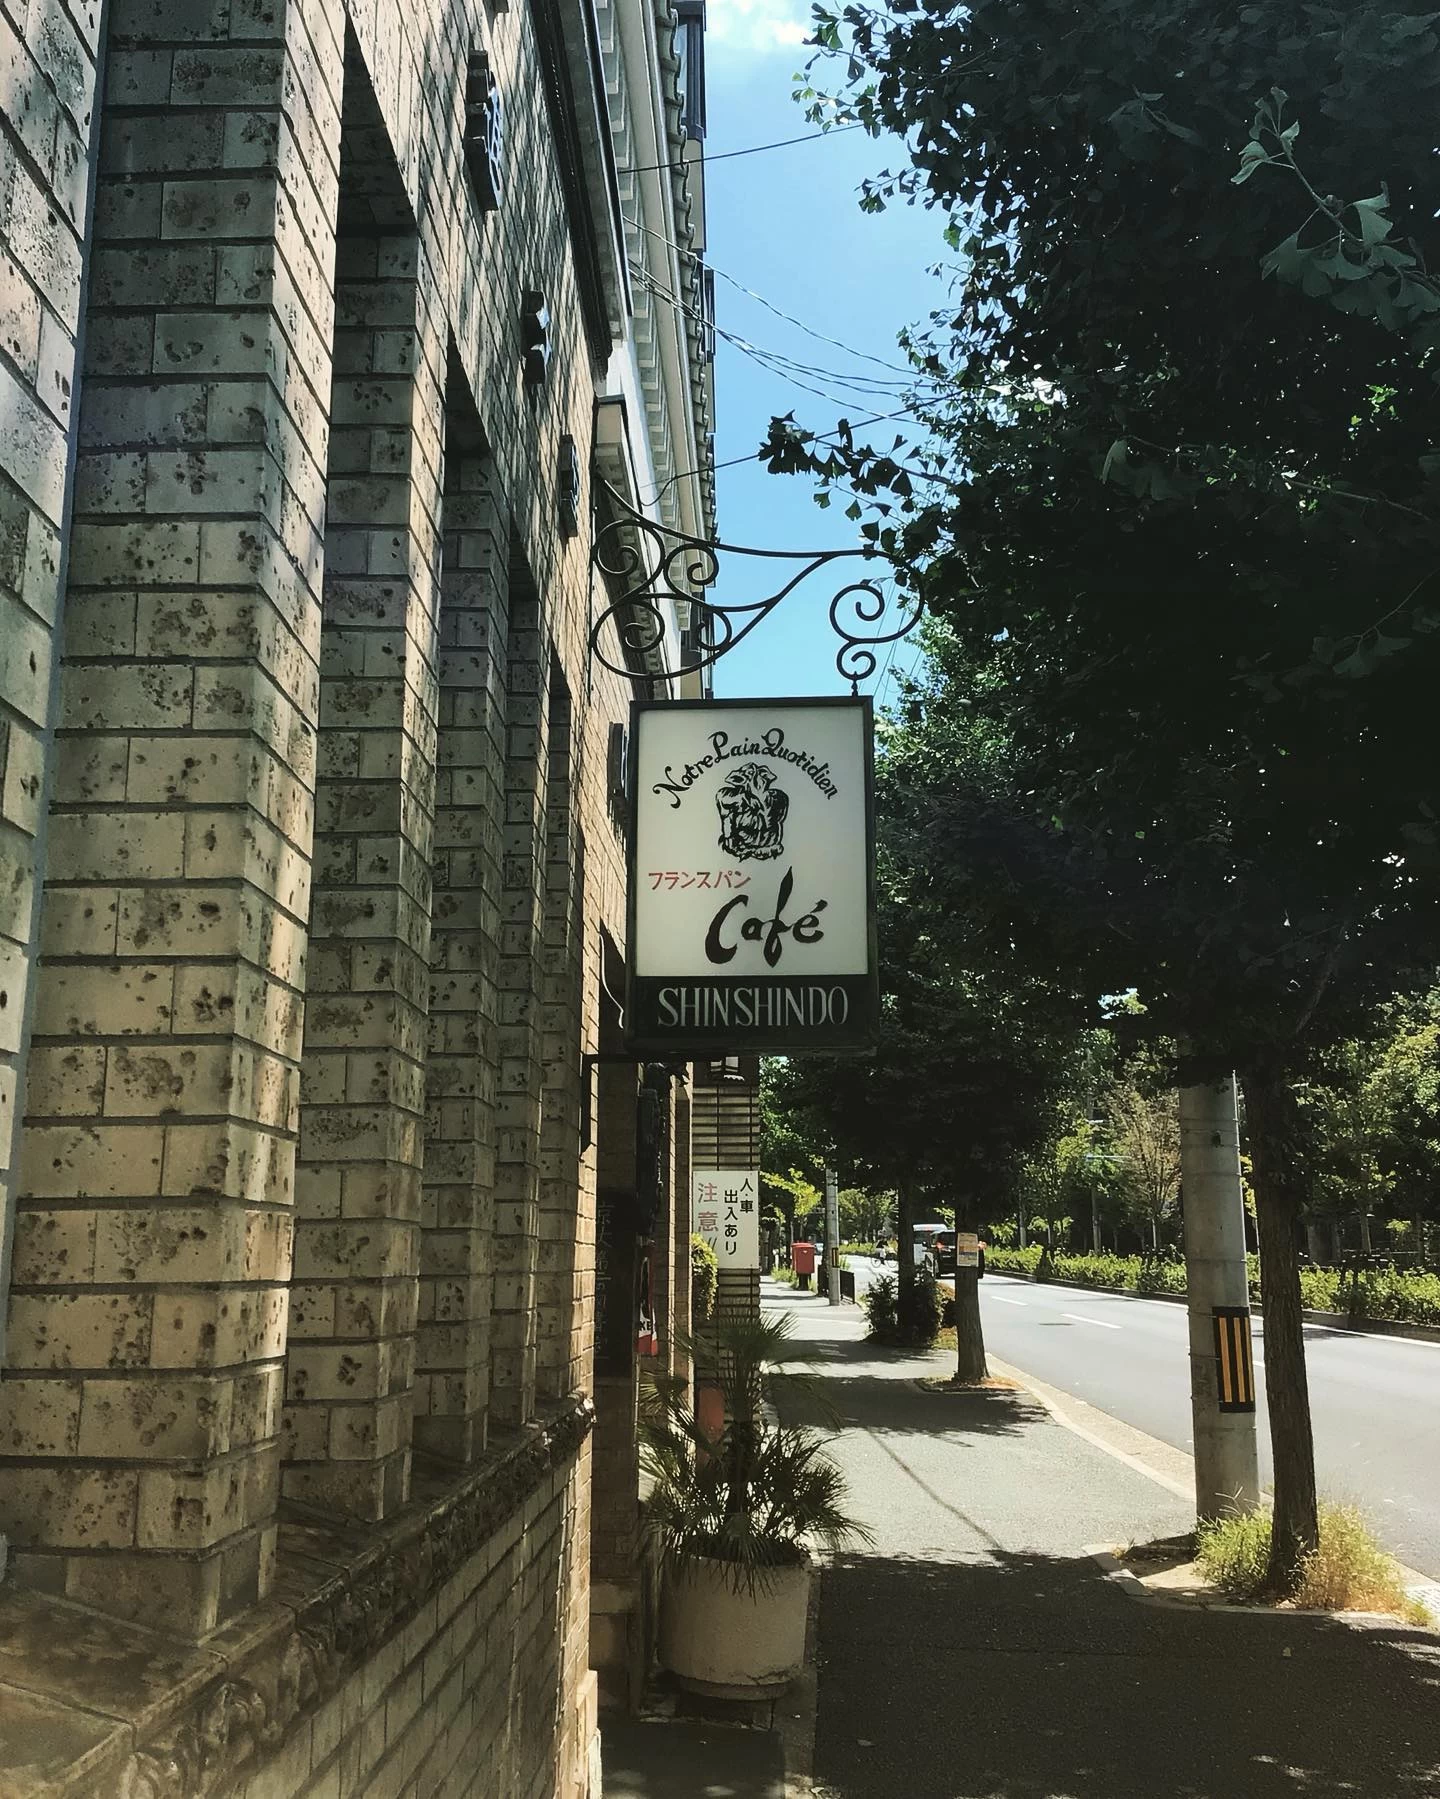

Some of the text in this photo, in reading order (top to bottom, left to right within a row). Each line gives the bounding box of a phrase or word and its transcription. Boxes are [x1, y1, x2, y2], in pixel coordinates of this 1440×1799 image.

[652, 728, 839, 809] Notre Pain Quotidien
[648, 870, 751, 890] フランスパン
[705, 866, 828, 968] Café
[657, 986, 849, 1027] SHINSHINDO
[724, 1189, 738, 1255] 出入あり
